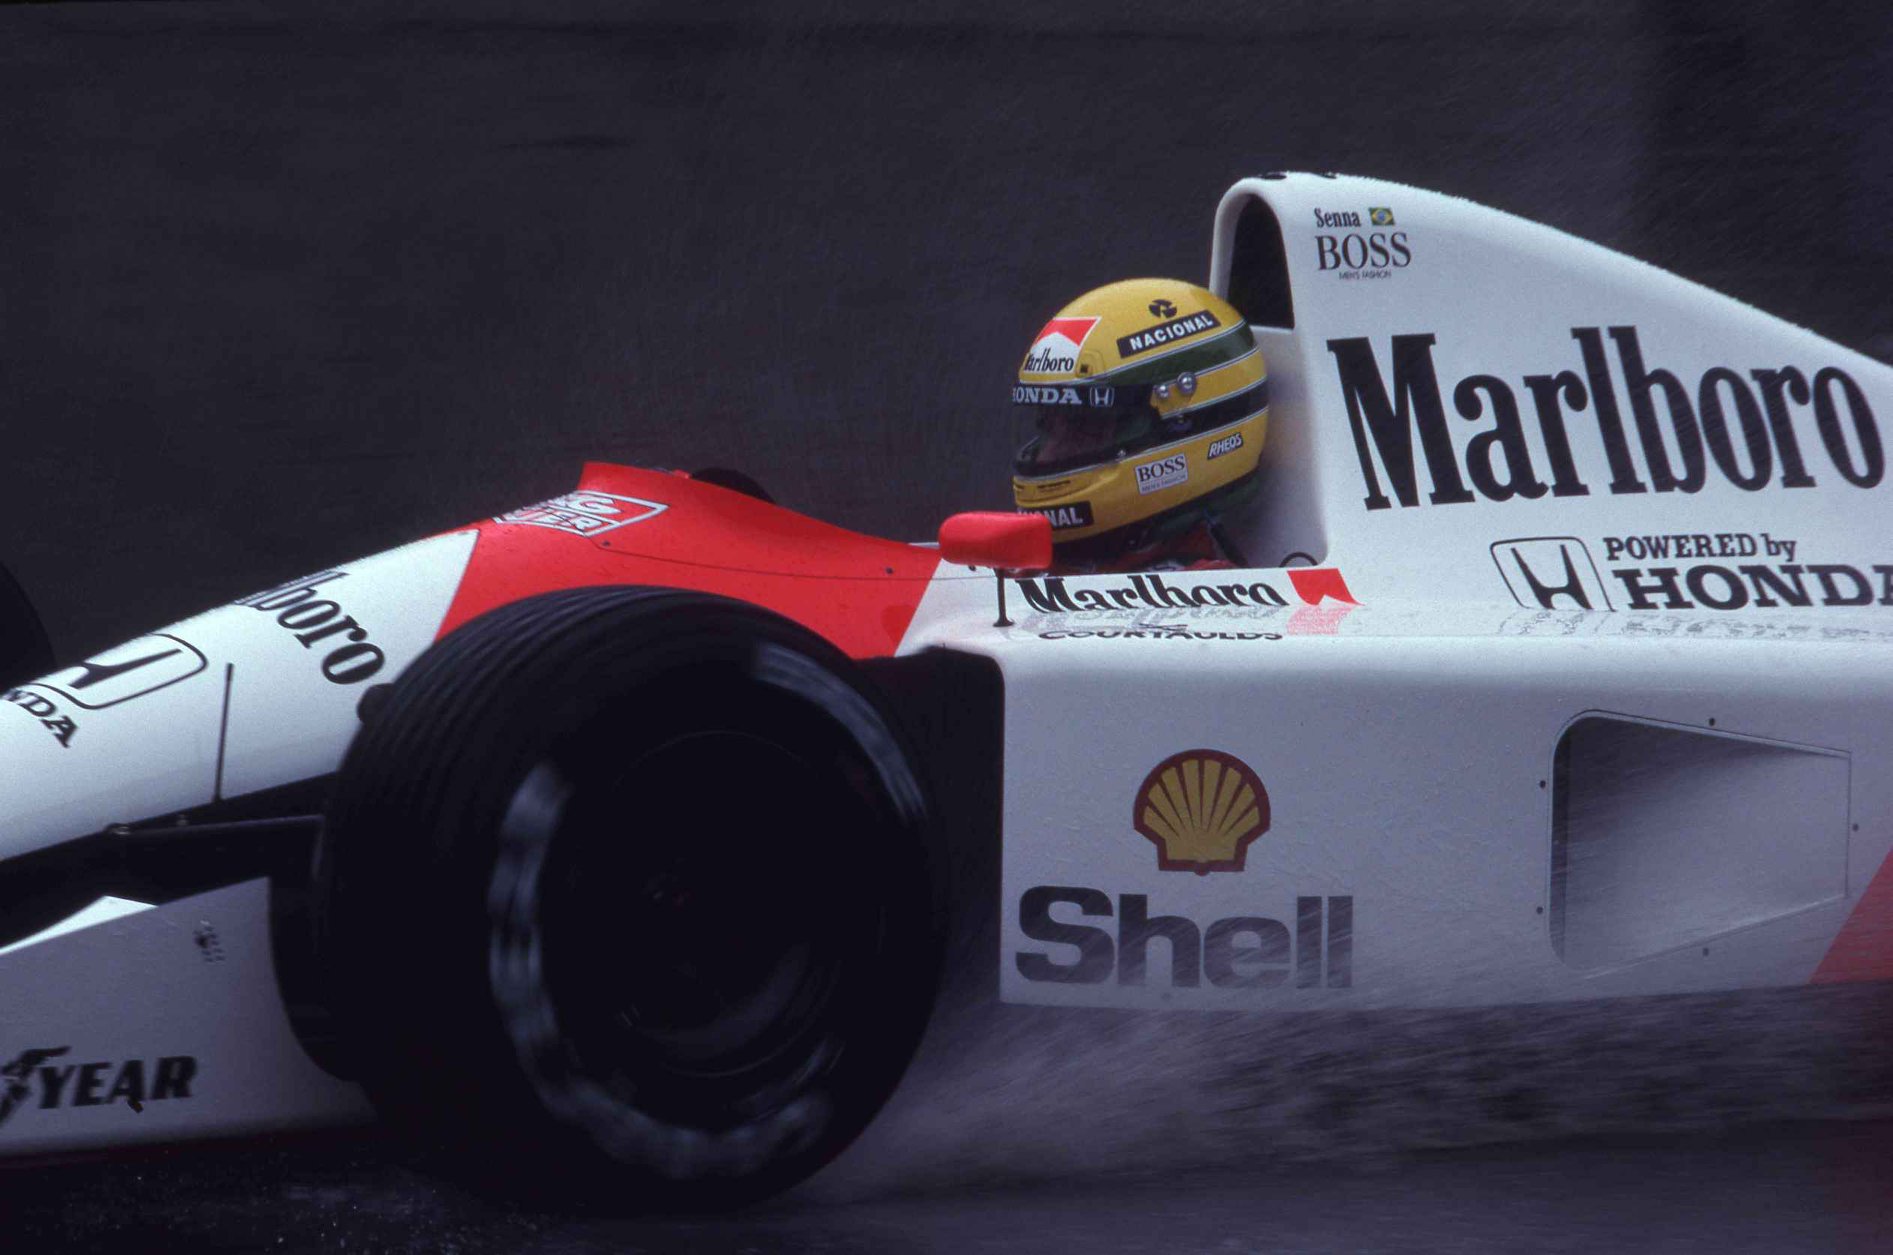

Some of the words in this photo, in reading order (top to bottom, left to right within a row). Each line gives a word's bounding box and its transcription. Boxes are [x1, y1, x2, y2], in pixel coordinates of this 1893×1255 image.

[1314, 208, 1361, 228] Senna
[1314, 232, 1412, 270] BOSS
[1128, 315, 1214, 351] NACIONAL
[1024, 347, 1075, 372] arlboro
[1327, 325, 1884, 511] Marlboro
[1208, 433, 1243, 457] RHEOS
[1137, 455, 1185, 481] BOSS
[1603, 533, 1758, 561] POWERED
[1760, 532, 1797, 562] by
[1015, 885, 1353, 989] Shell
